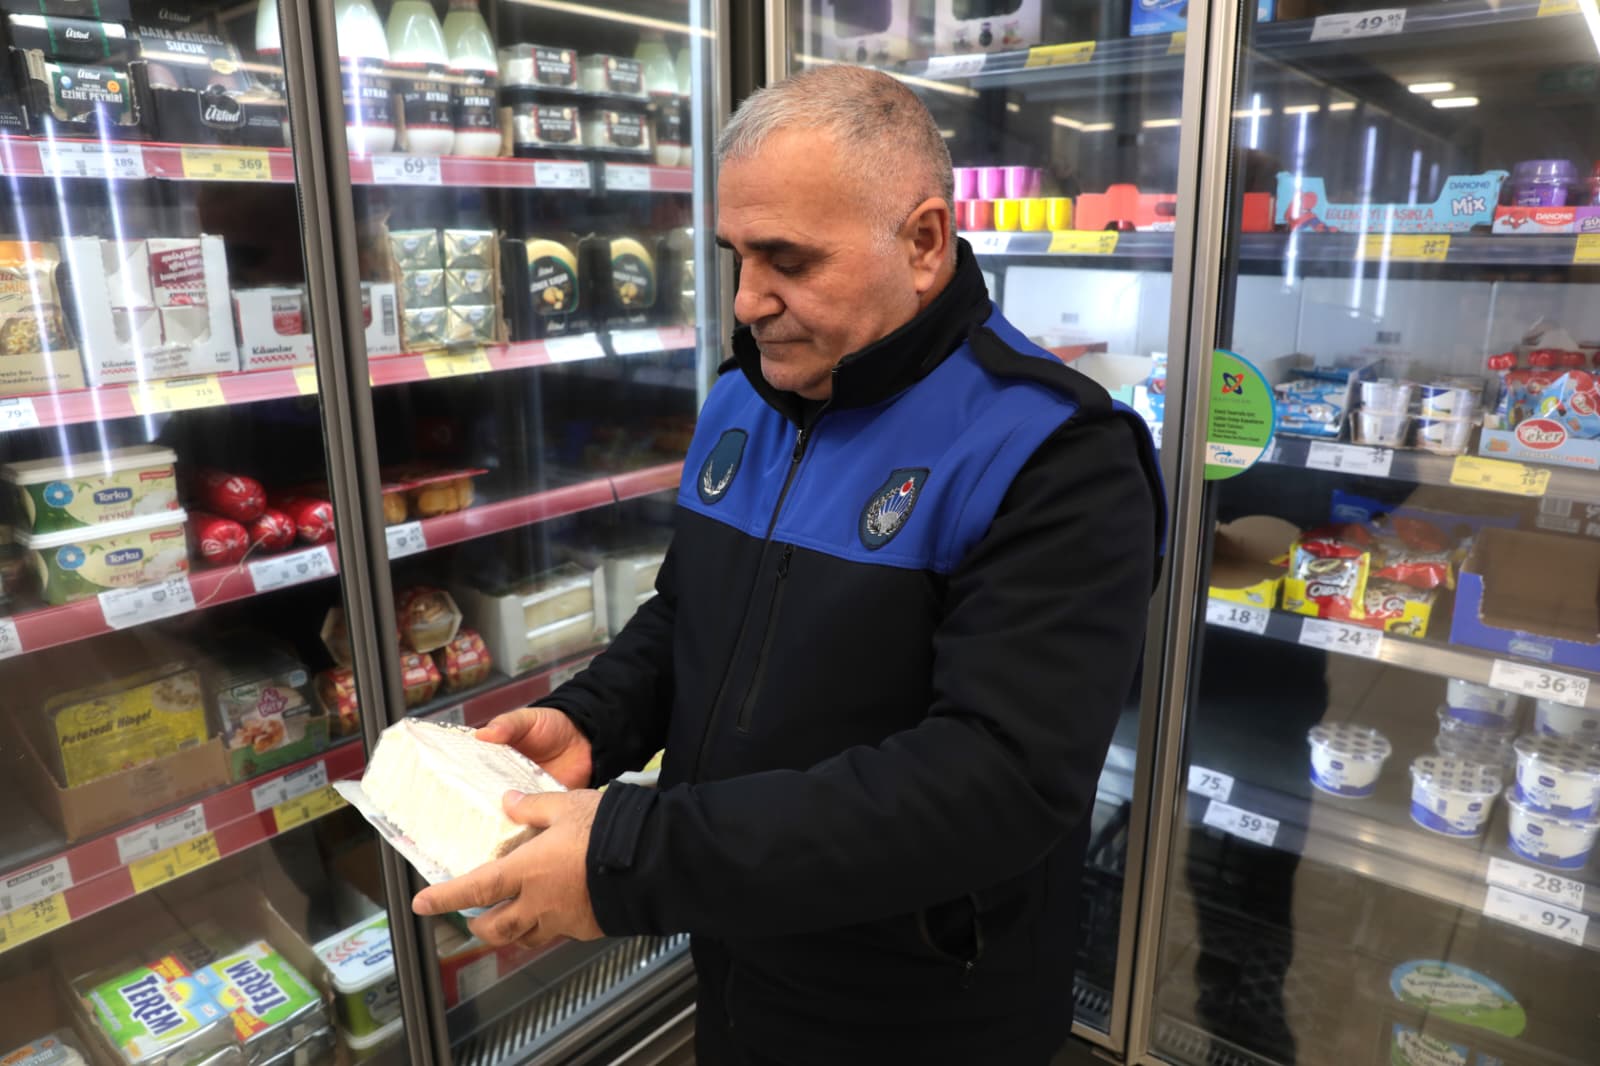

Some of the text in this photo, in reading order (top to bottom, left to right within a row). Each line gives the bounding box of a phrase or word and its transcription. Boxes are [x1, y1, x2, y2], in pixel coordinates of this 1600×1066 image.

[167, 40, 206, 55] SUCUK
[239, 158, 263, 170] 369
[97, 490, 129, 502] Torku
[109, 551, 140, 563] Torku
[1199, 773, 1221, 790] 75
[1541, 911, 1571, 930] 97
[224, 959, 288, 1016] TEREM
[120, 974, 184, 1036] TEREM
